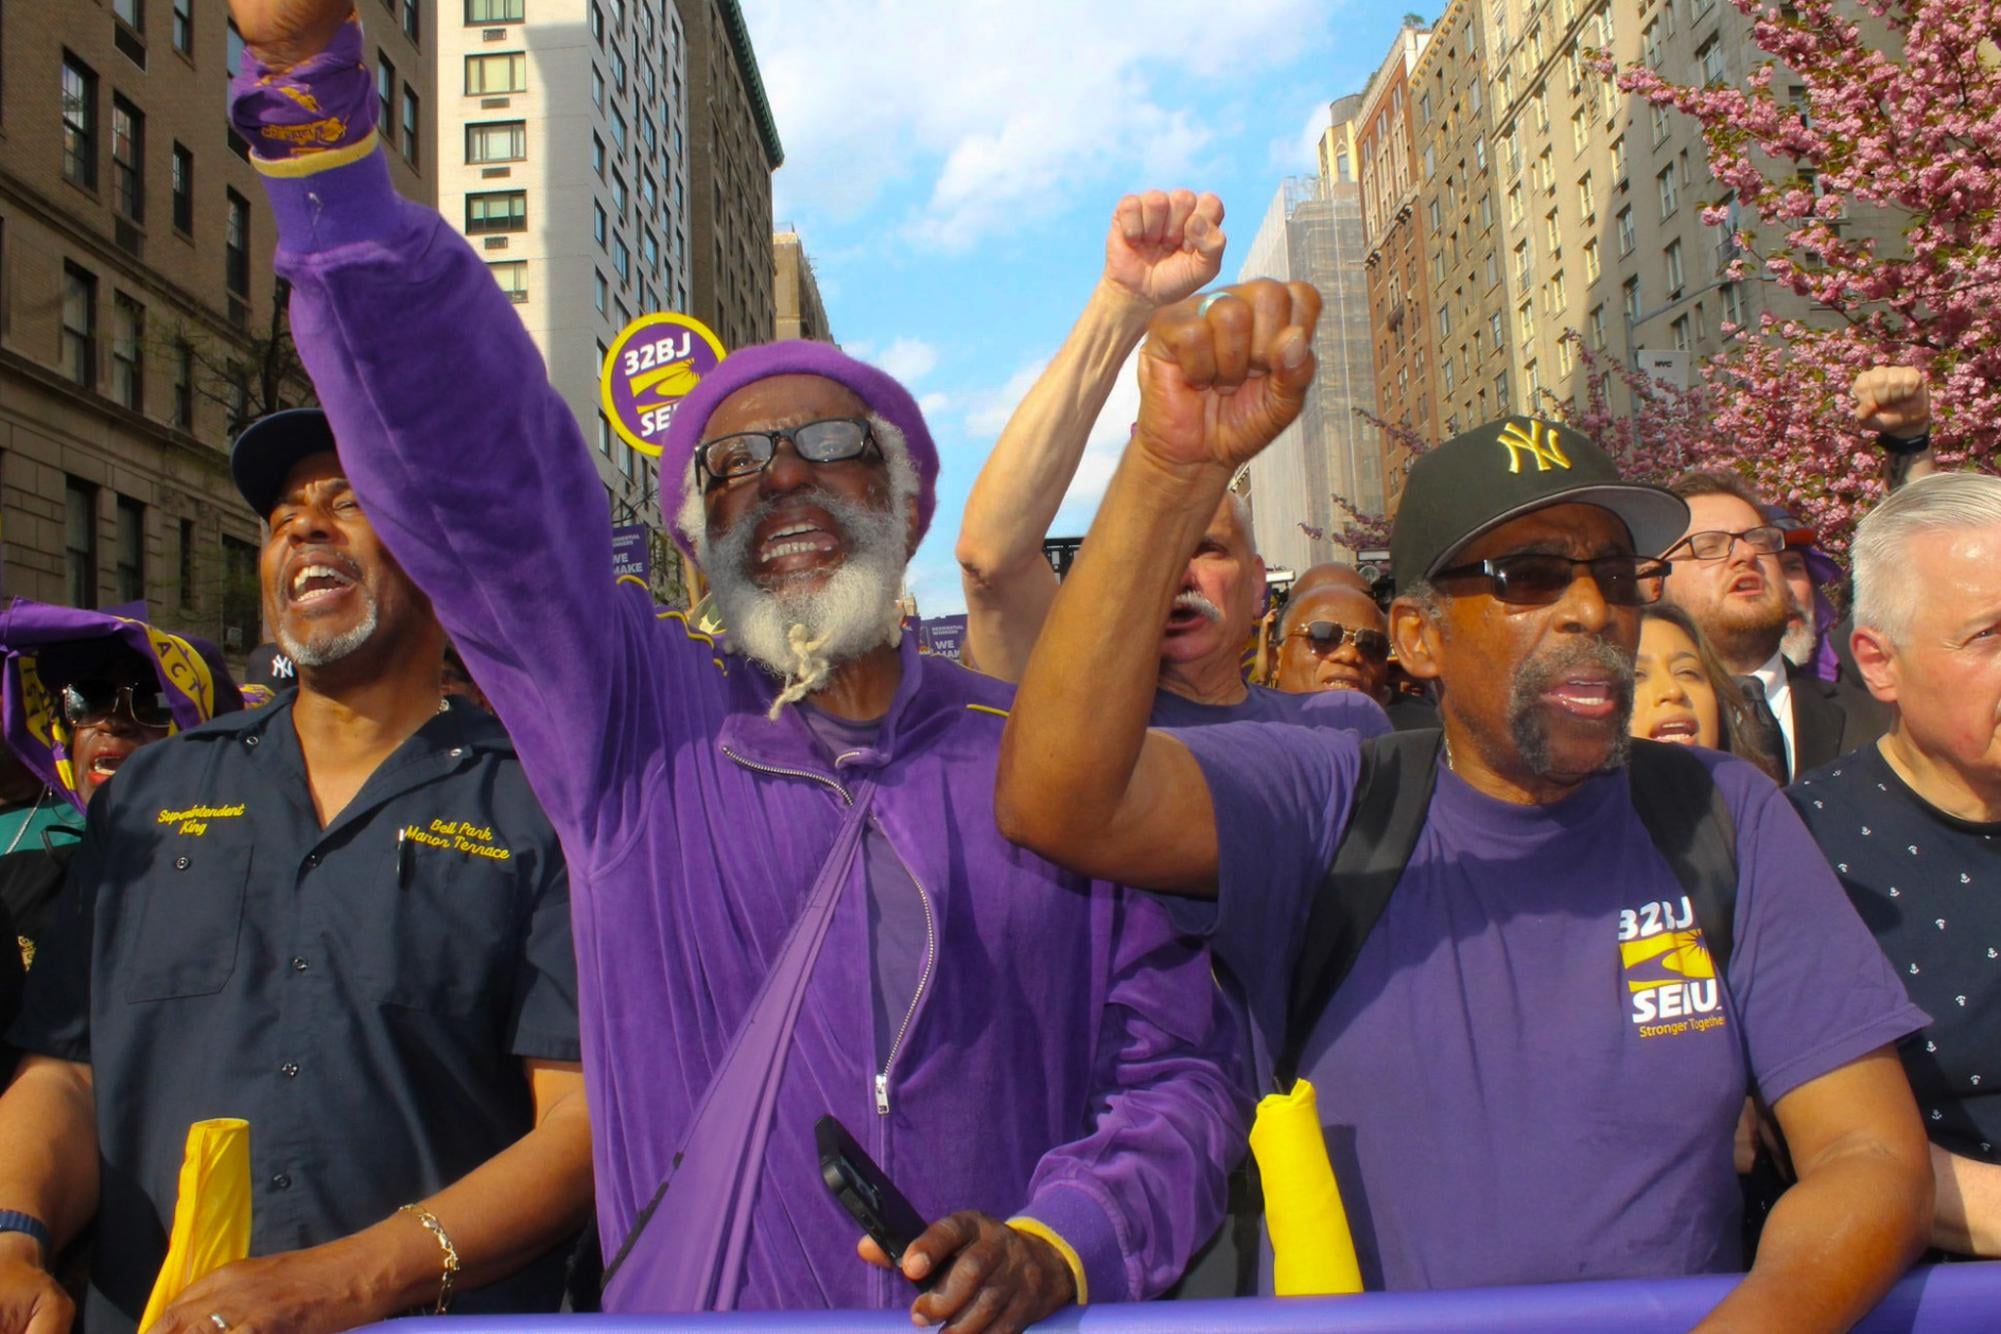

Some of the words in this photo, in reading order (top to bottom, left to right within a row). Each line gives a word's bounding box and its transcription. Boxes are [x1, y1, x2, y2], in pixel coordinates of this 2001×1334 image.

[624, 332, 691, 376] 32BJ
[640, 401, 679, 437] SE
[1496, 419, 1571, 474] NY
[935, 640, 955, 649] WE
[272, 654, 294, 679] NY
[179, 819, 208, 836] King
[404, 825, 450, 848] Manor
[454, 836, 510, 859] Terrace
[430, 819, 458, 835] Bell
[458, 822, 493, 841] Park
[1632, 978, 1719, 1024] SEIU
[1639, 1020, 1688, 1038] Stronger
